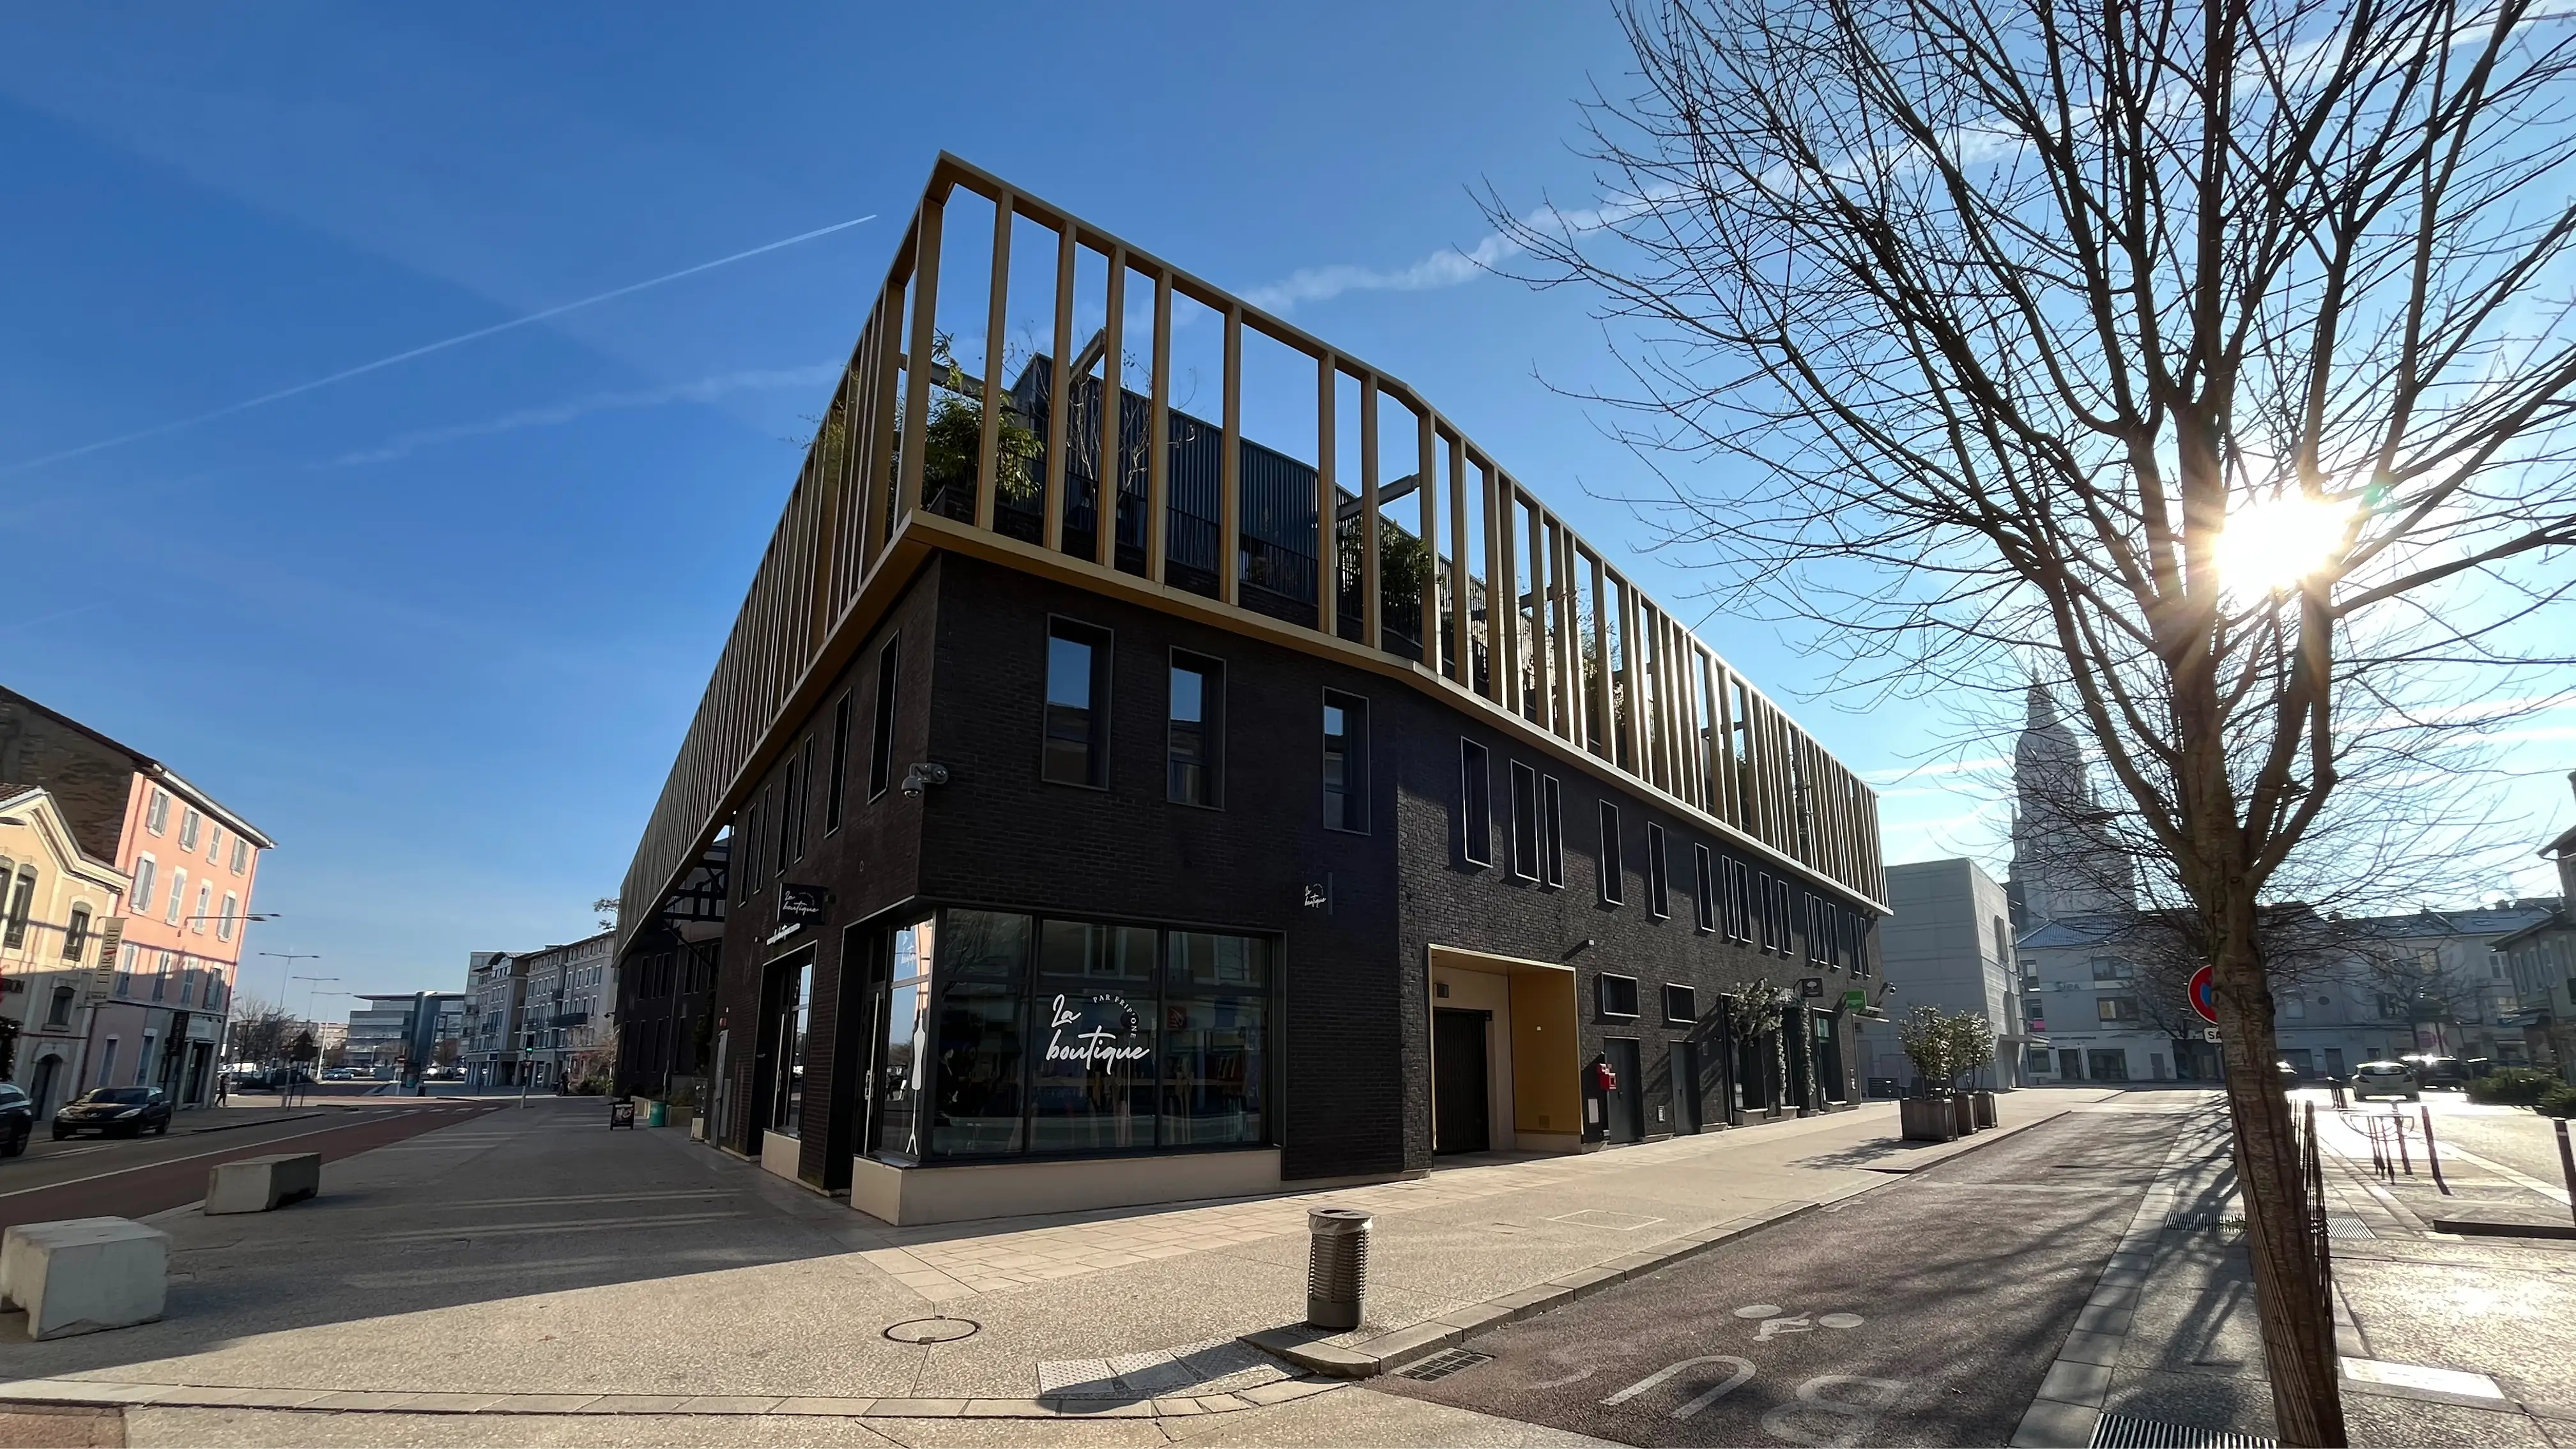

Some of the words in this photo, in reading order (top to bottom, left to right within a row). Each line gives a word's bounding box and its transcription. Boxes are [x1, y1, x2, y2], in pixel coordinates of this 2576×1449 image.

[96, 926, 119, 984] LIBRAIRIE
[1051, 993, 1082, 1027] La
[1093, 993, 1110, 1003] PAR
[1046, 1025, 1150, 1075] boutique
